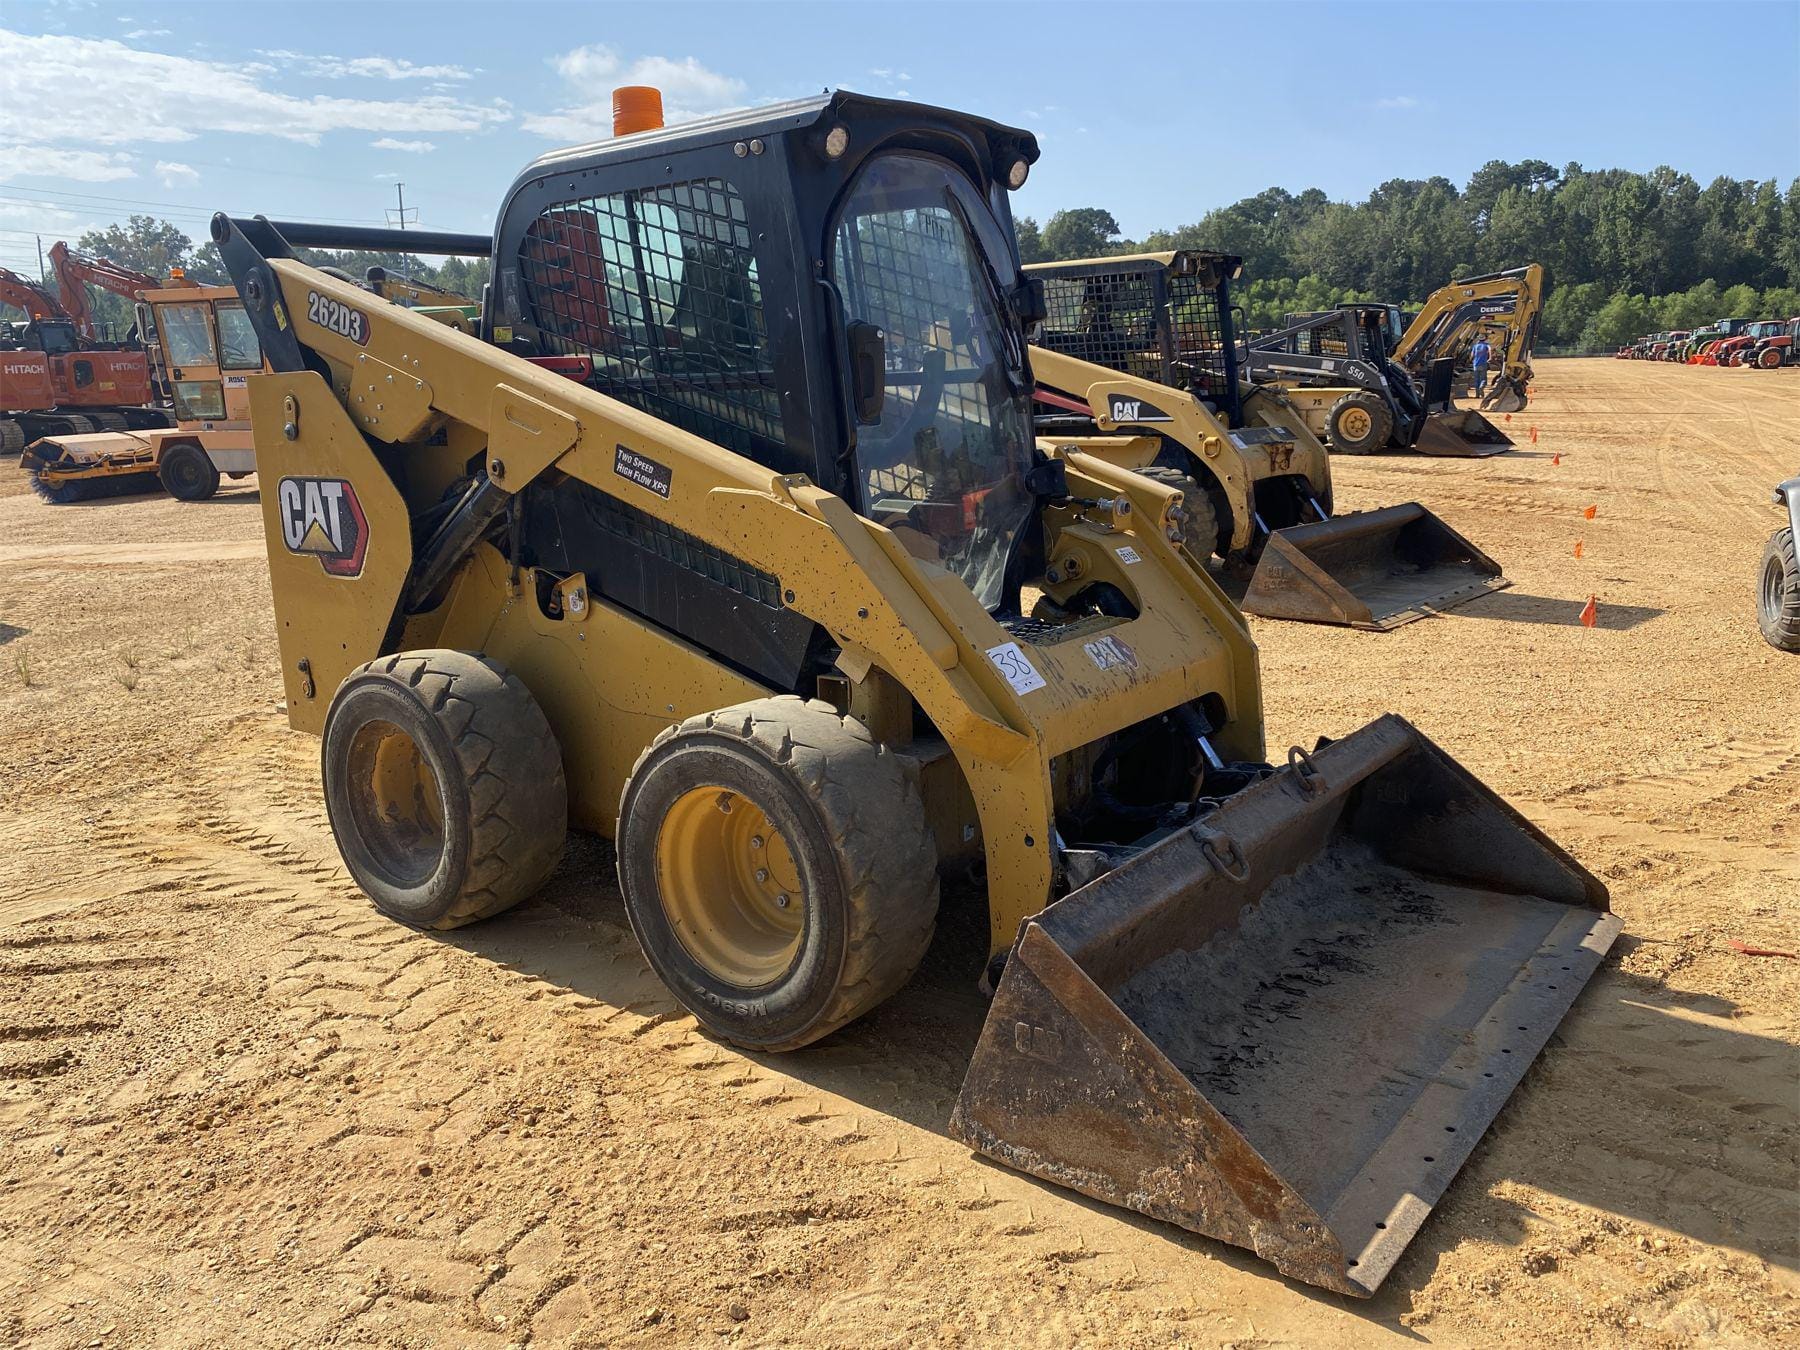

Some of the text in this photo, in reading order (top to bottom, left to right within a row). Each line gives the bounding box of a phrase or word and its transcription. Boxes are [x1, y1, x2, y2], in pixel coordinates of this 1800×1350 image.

[308, 292, 361, 341] 262D3
[3, 364, 45, 375] HITACHI
[1347, 365, 1365, 380] S50
[1113, 401, 1140, 421] CAT
[617, 449, 654, 474] TWO SPEED
[616, 462, 668, 494] HIGH FLOW XPS
[280, 480, 343, 552] CAT
